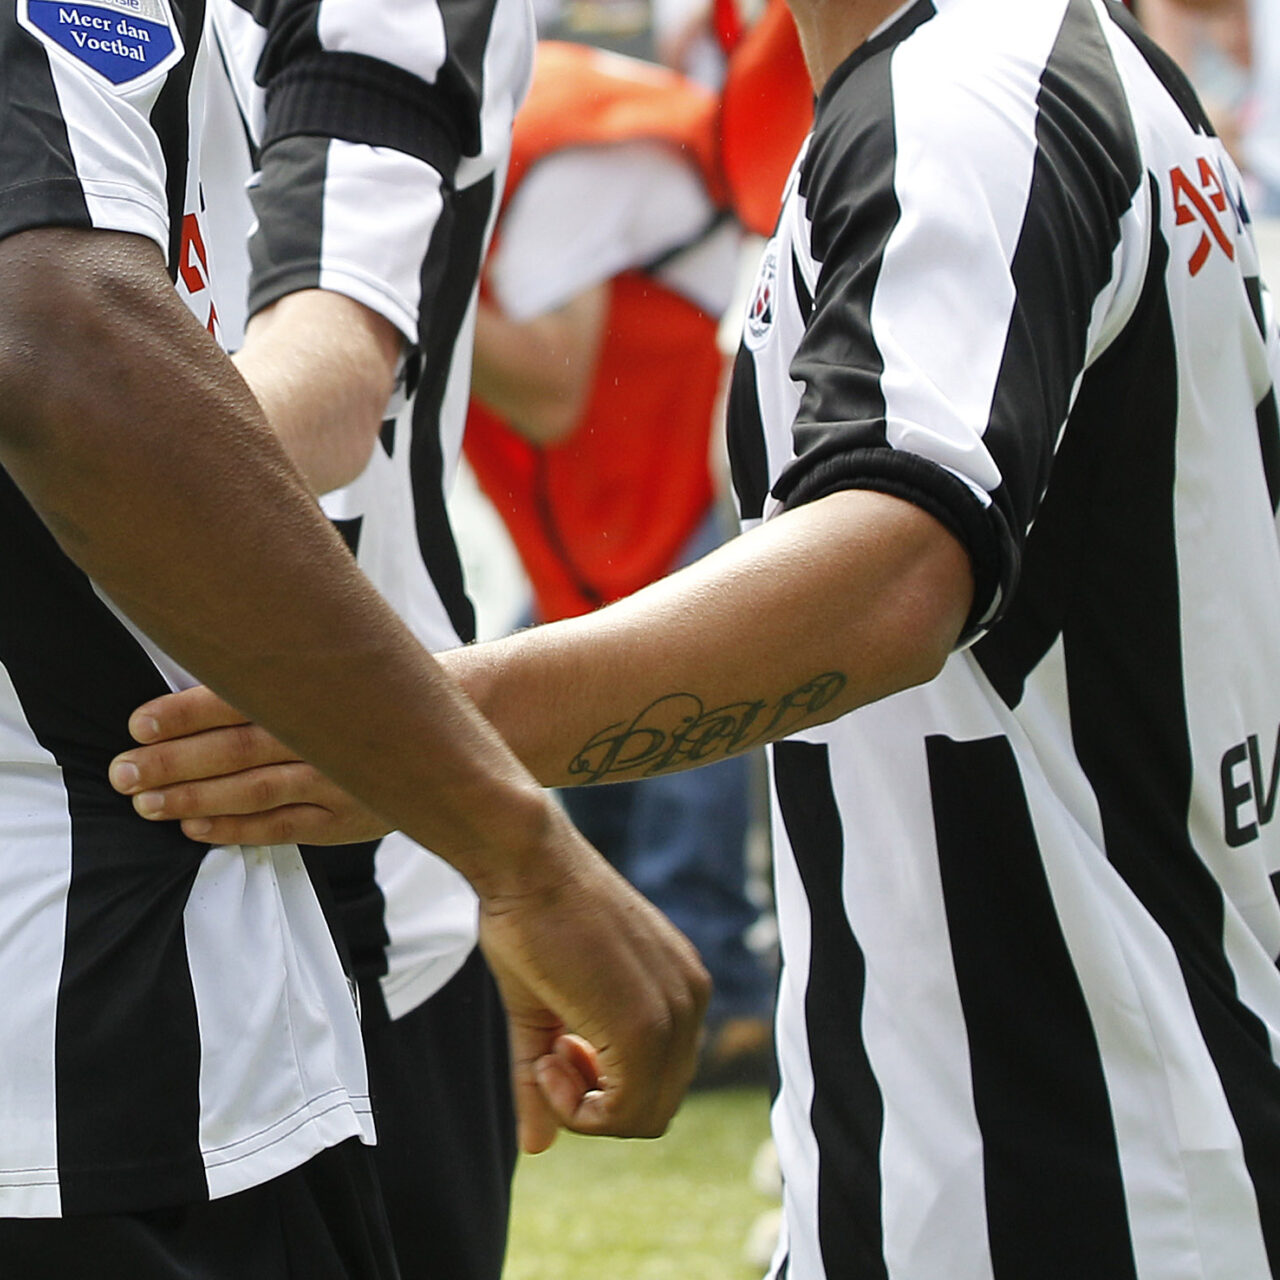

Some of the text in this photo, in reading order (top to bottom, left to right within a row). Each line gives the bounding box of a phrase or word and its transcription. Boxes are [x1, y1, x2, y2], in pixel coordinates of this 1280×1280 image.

[59, 7, 112, 32] Meer
[116, 19, 151, 43] dan
[70, 30, 146, 63] Voetbal
